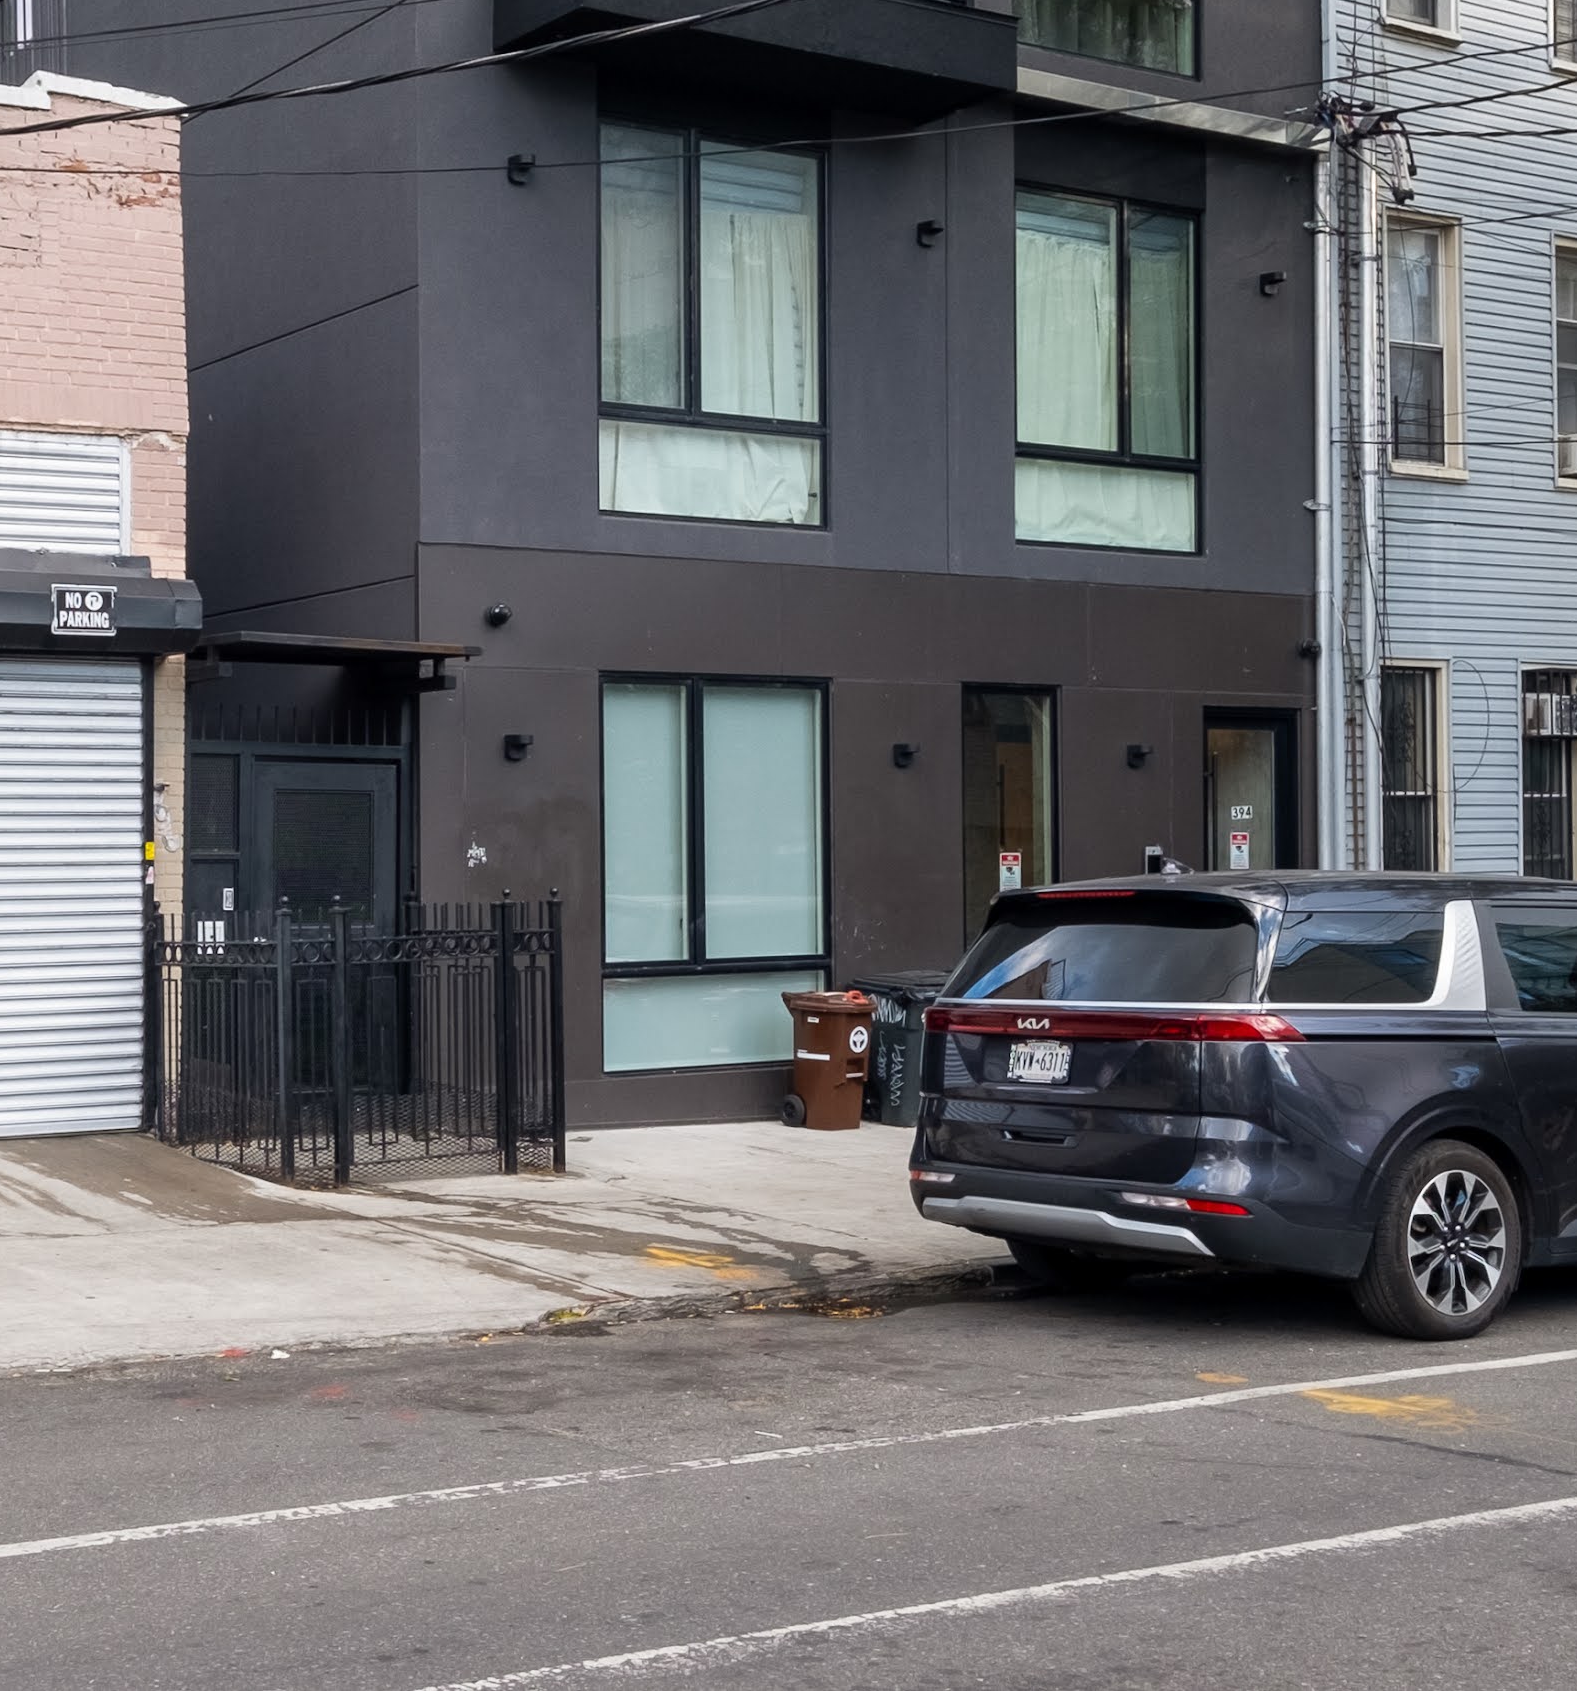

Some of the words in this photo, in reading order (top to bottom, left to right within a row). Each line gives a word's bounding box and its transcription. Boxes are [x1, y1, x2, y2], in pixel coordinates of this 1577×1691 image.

[65, 591, 82, 609] NO
[59, 610, 110, 628] PARKING
[1232, 806, 1251, 818] 394
[1017, 1018, 1050, 1029] KIA
